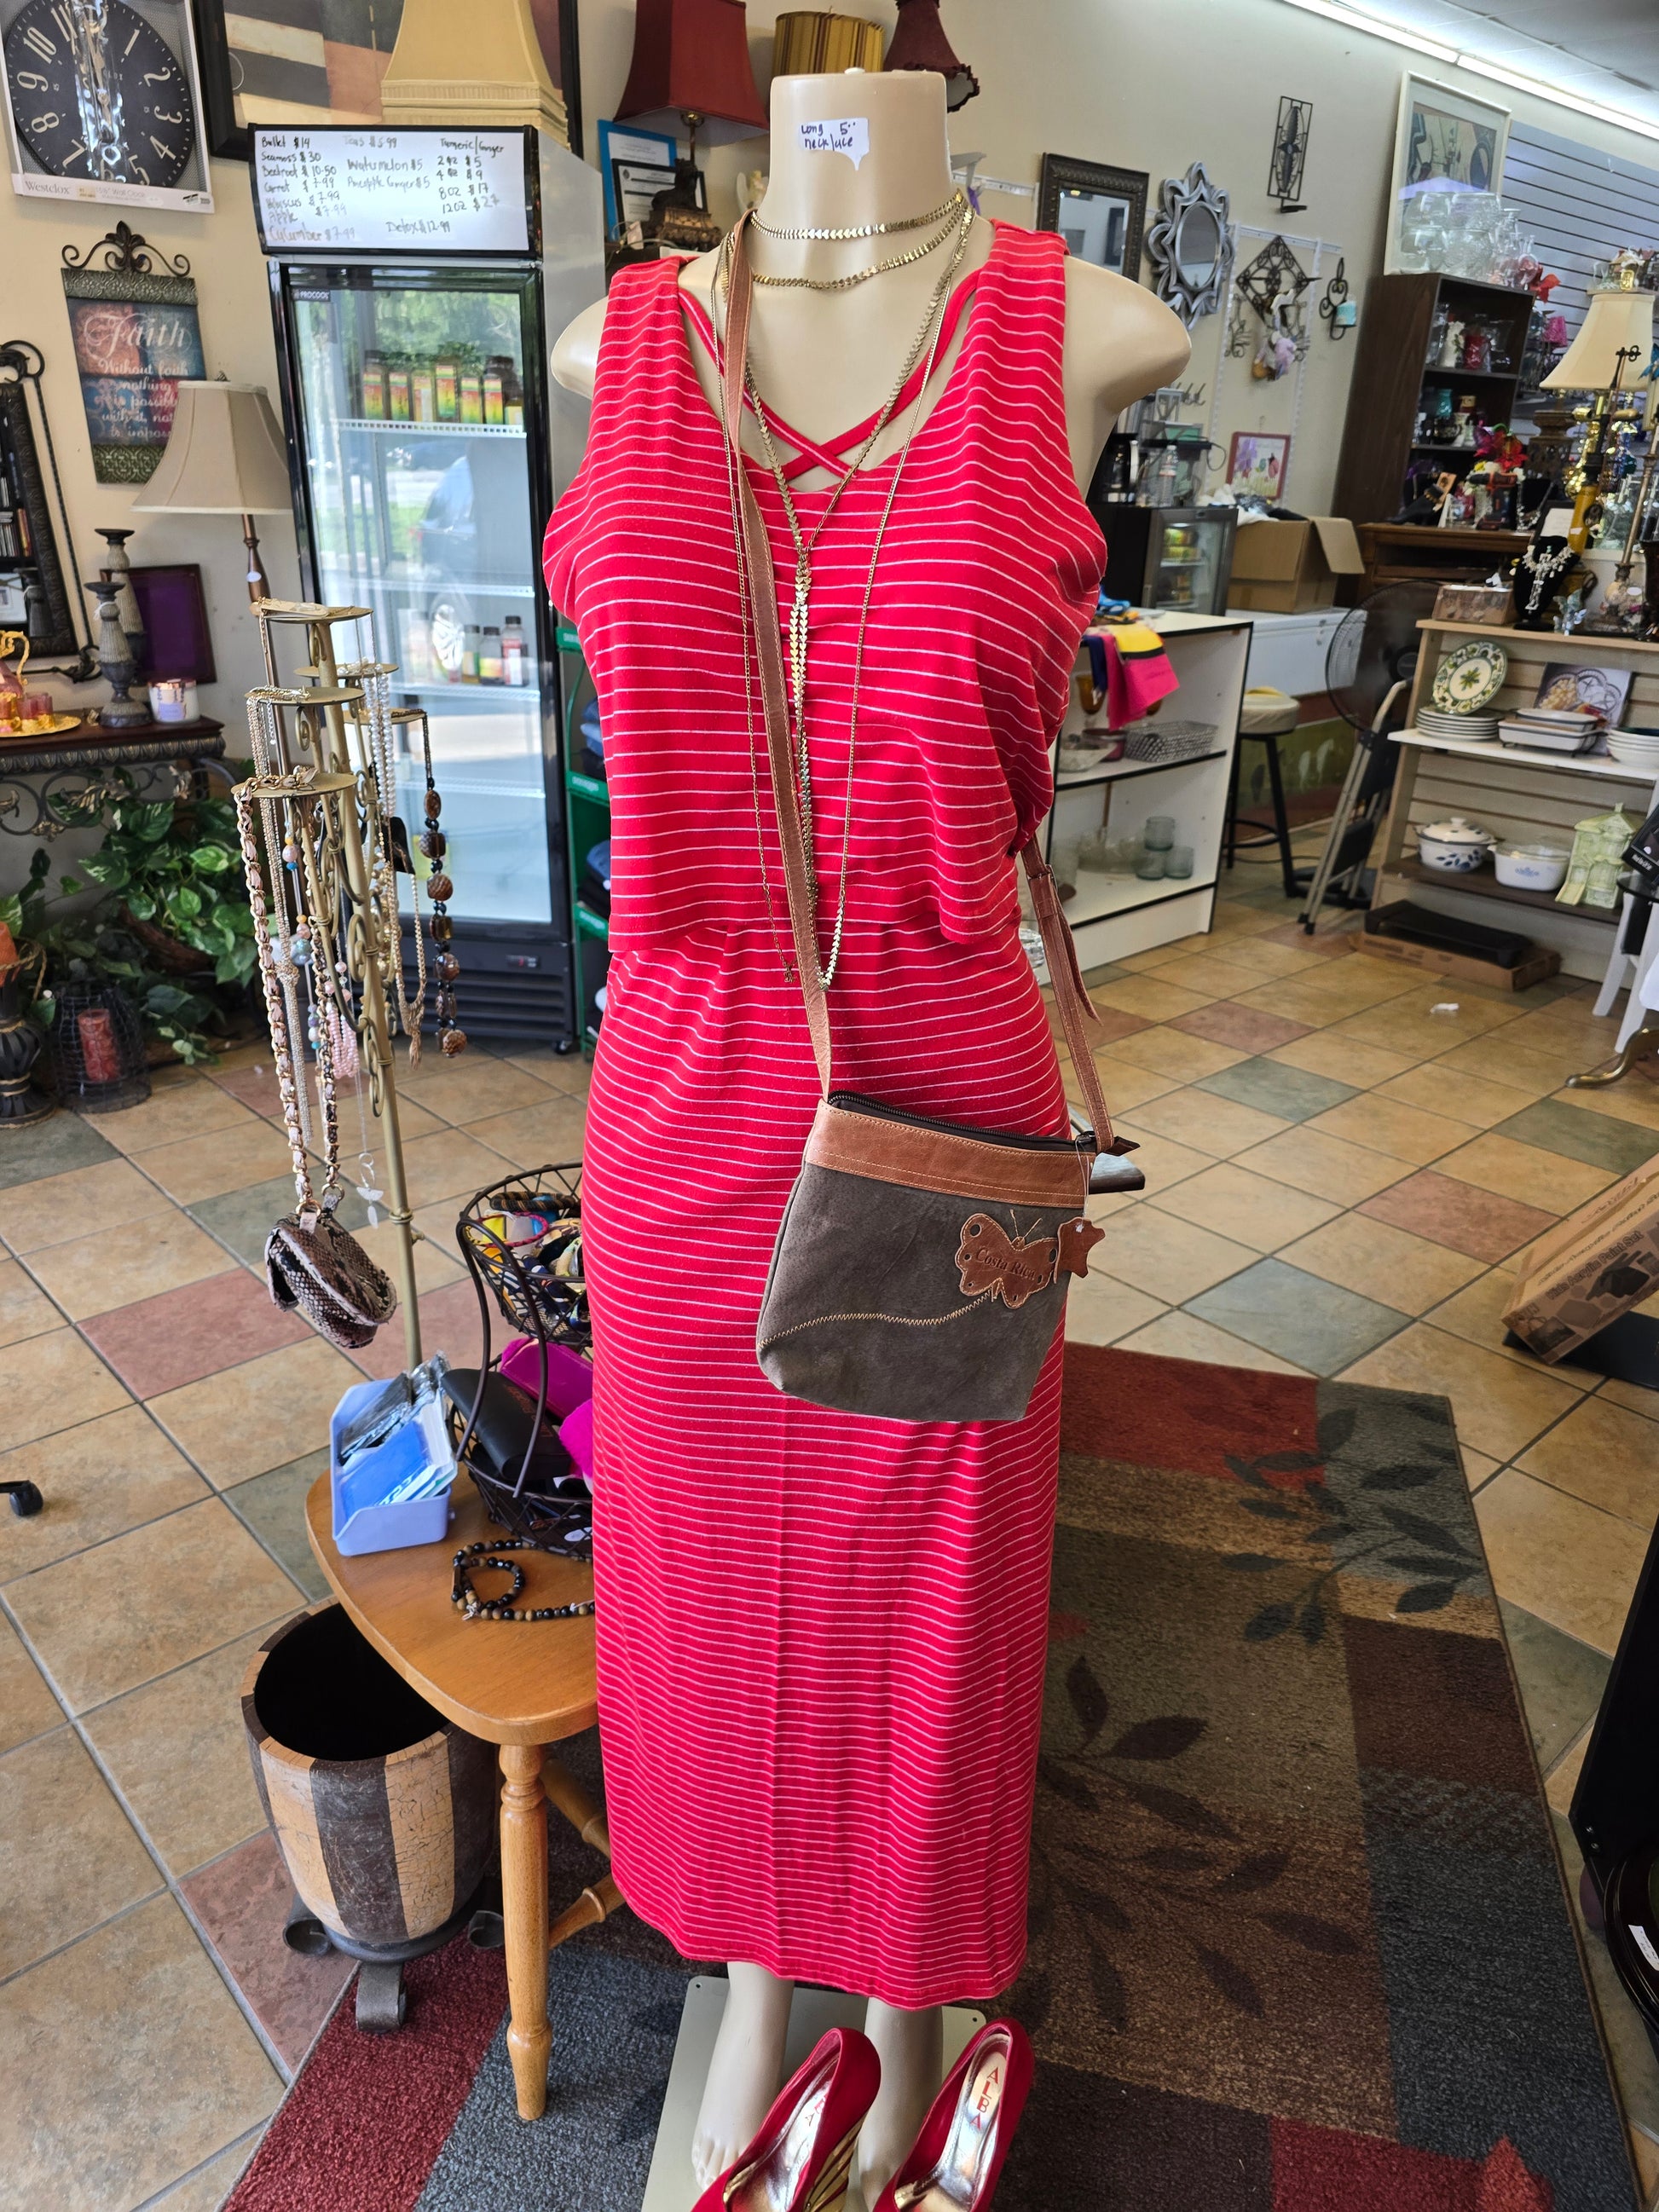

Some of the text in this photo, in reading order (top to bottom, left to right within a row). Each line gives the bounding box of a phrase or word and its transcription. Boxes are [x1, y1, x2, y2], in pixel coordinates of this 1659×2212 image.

[23, 26, 56, 64] 10
[124, 29, 140, 56] 1
[17, 71, 49, 92] 9
[143, 66, 171, 87] 2
[31, 112, 60, 133] 8
[153, 105, 182, 124] 3
[62, 139, 85, 169] 7
[149, 136, 176, 159] 4
[128, 154, 150, 186] 5
[25, 180, 70, 194] Westclox
[84, 312, 189, 361] Faith
[98, 359, 153, 376] Without
[1598, 1241, 1627, 1264] Paint
[1622, 1230, 1645, 1250] Set
[976, 1245, 1036, 1281] Costa Rica
[969, 2066, 1000, 2131] ALBA
